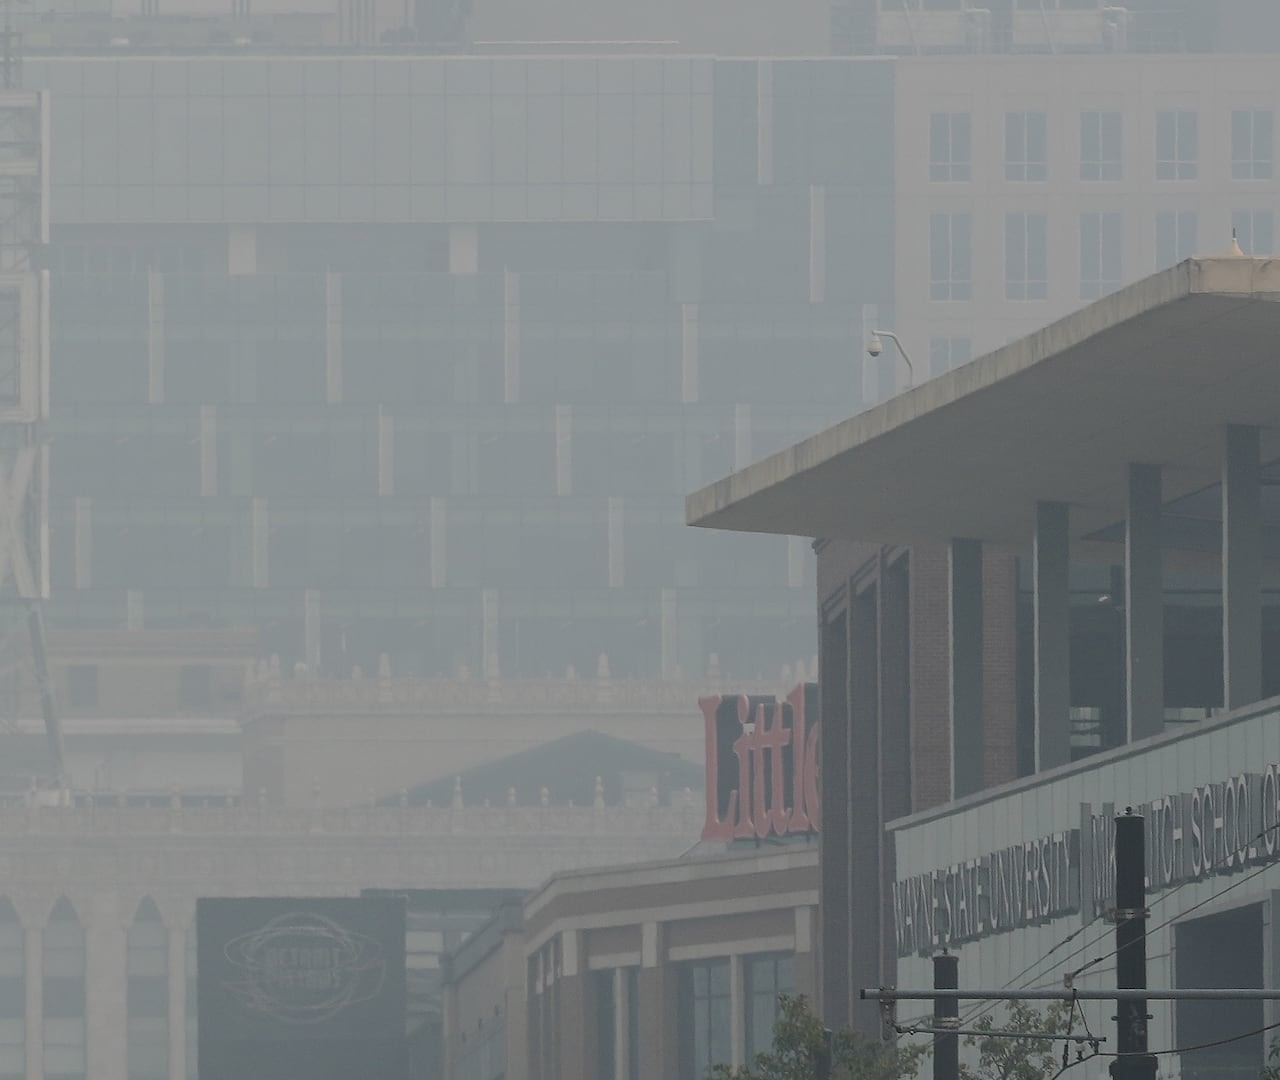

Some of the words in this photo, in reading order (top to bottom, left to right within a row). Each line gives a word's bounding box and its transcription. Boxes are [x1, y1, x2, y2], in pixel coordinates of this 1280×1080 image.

[945, 858, 983, 942] STATE
[989, 831, 1071, 929] UNIVERSITY
[1192, 773, 1257, 877] SCHOOL
